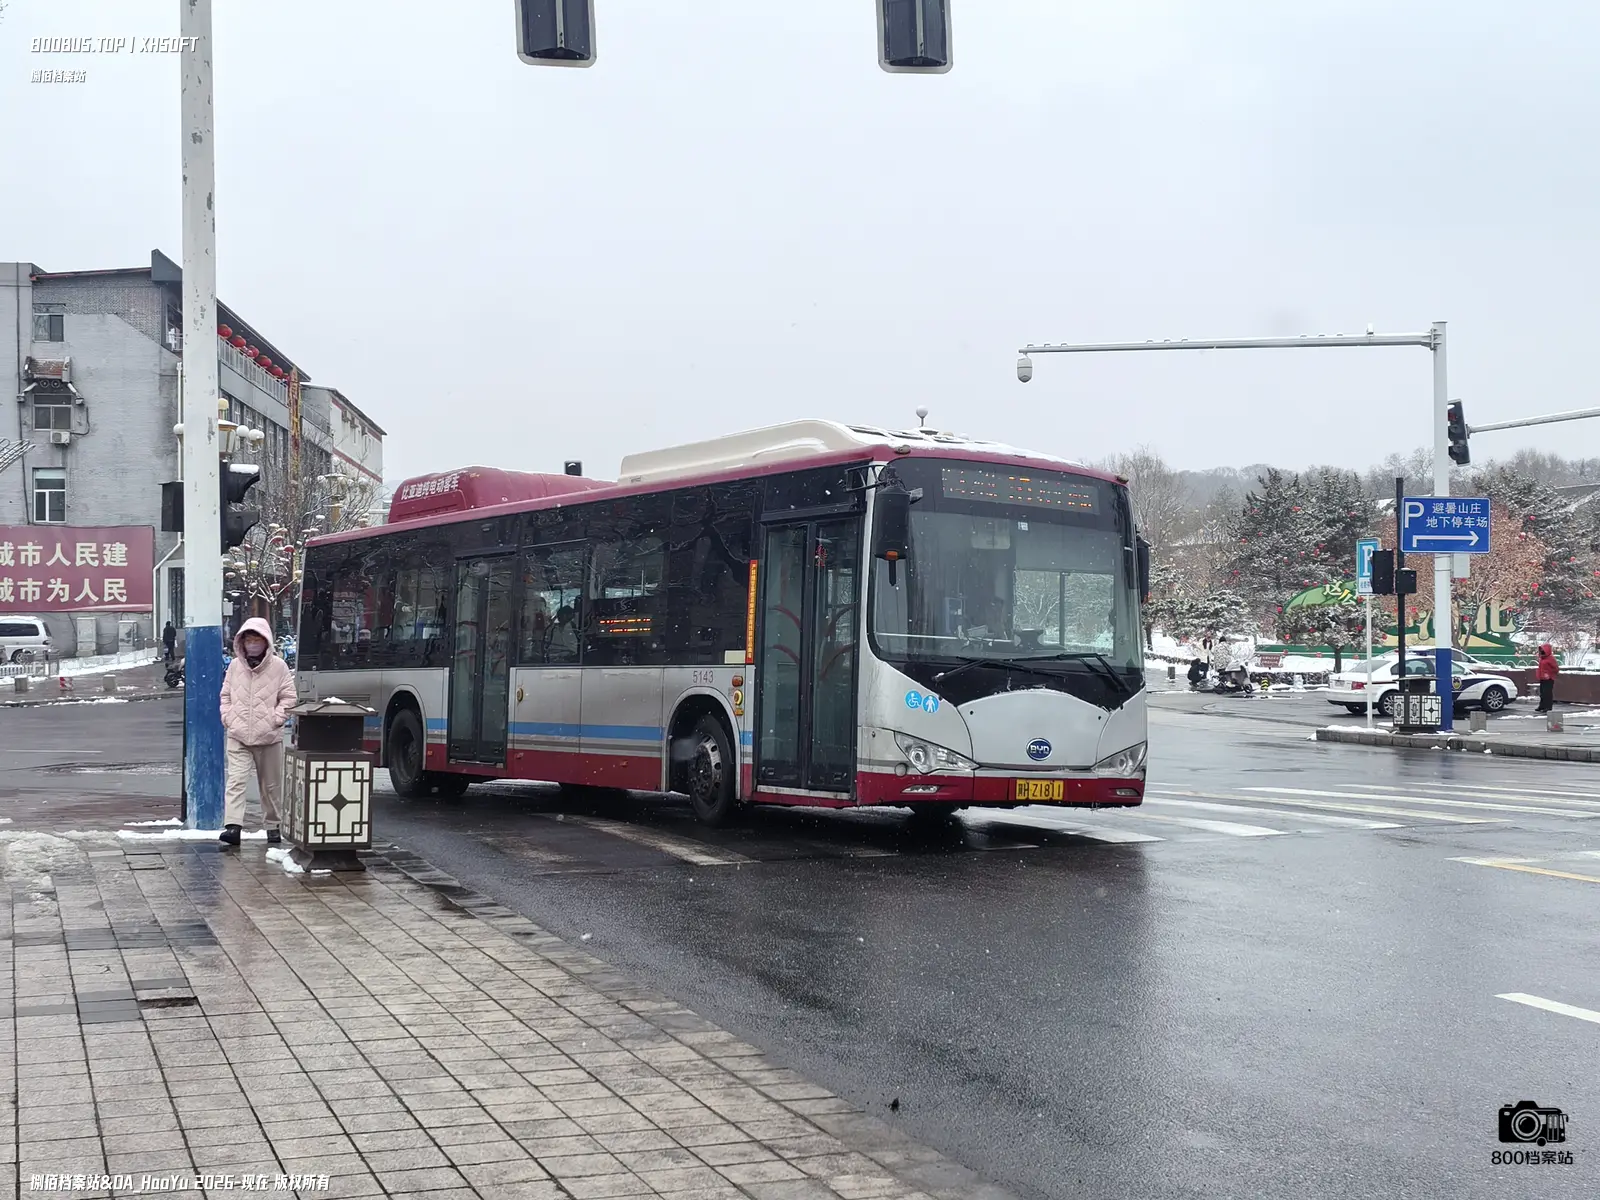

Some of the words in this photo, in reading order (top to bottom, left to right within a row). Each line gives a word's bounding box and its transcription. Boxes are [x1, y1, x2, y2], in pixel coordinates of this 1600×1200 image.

[401, 473, 460, 500] 比亚迪纯电动客车
[1432, 502, 1482, 514] 避暑山庄
[1404, 502, 1425, 528] P
[1426, 516, 1488, 528] 地下停车场
[692, 671, 714, 684] 5143
